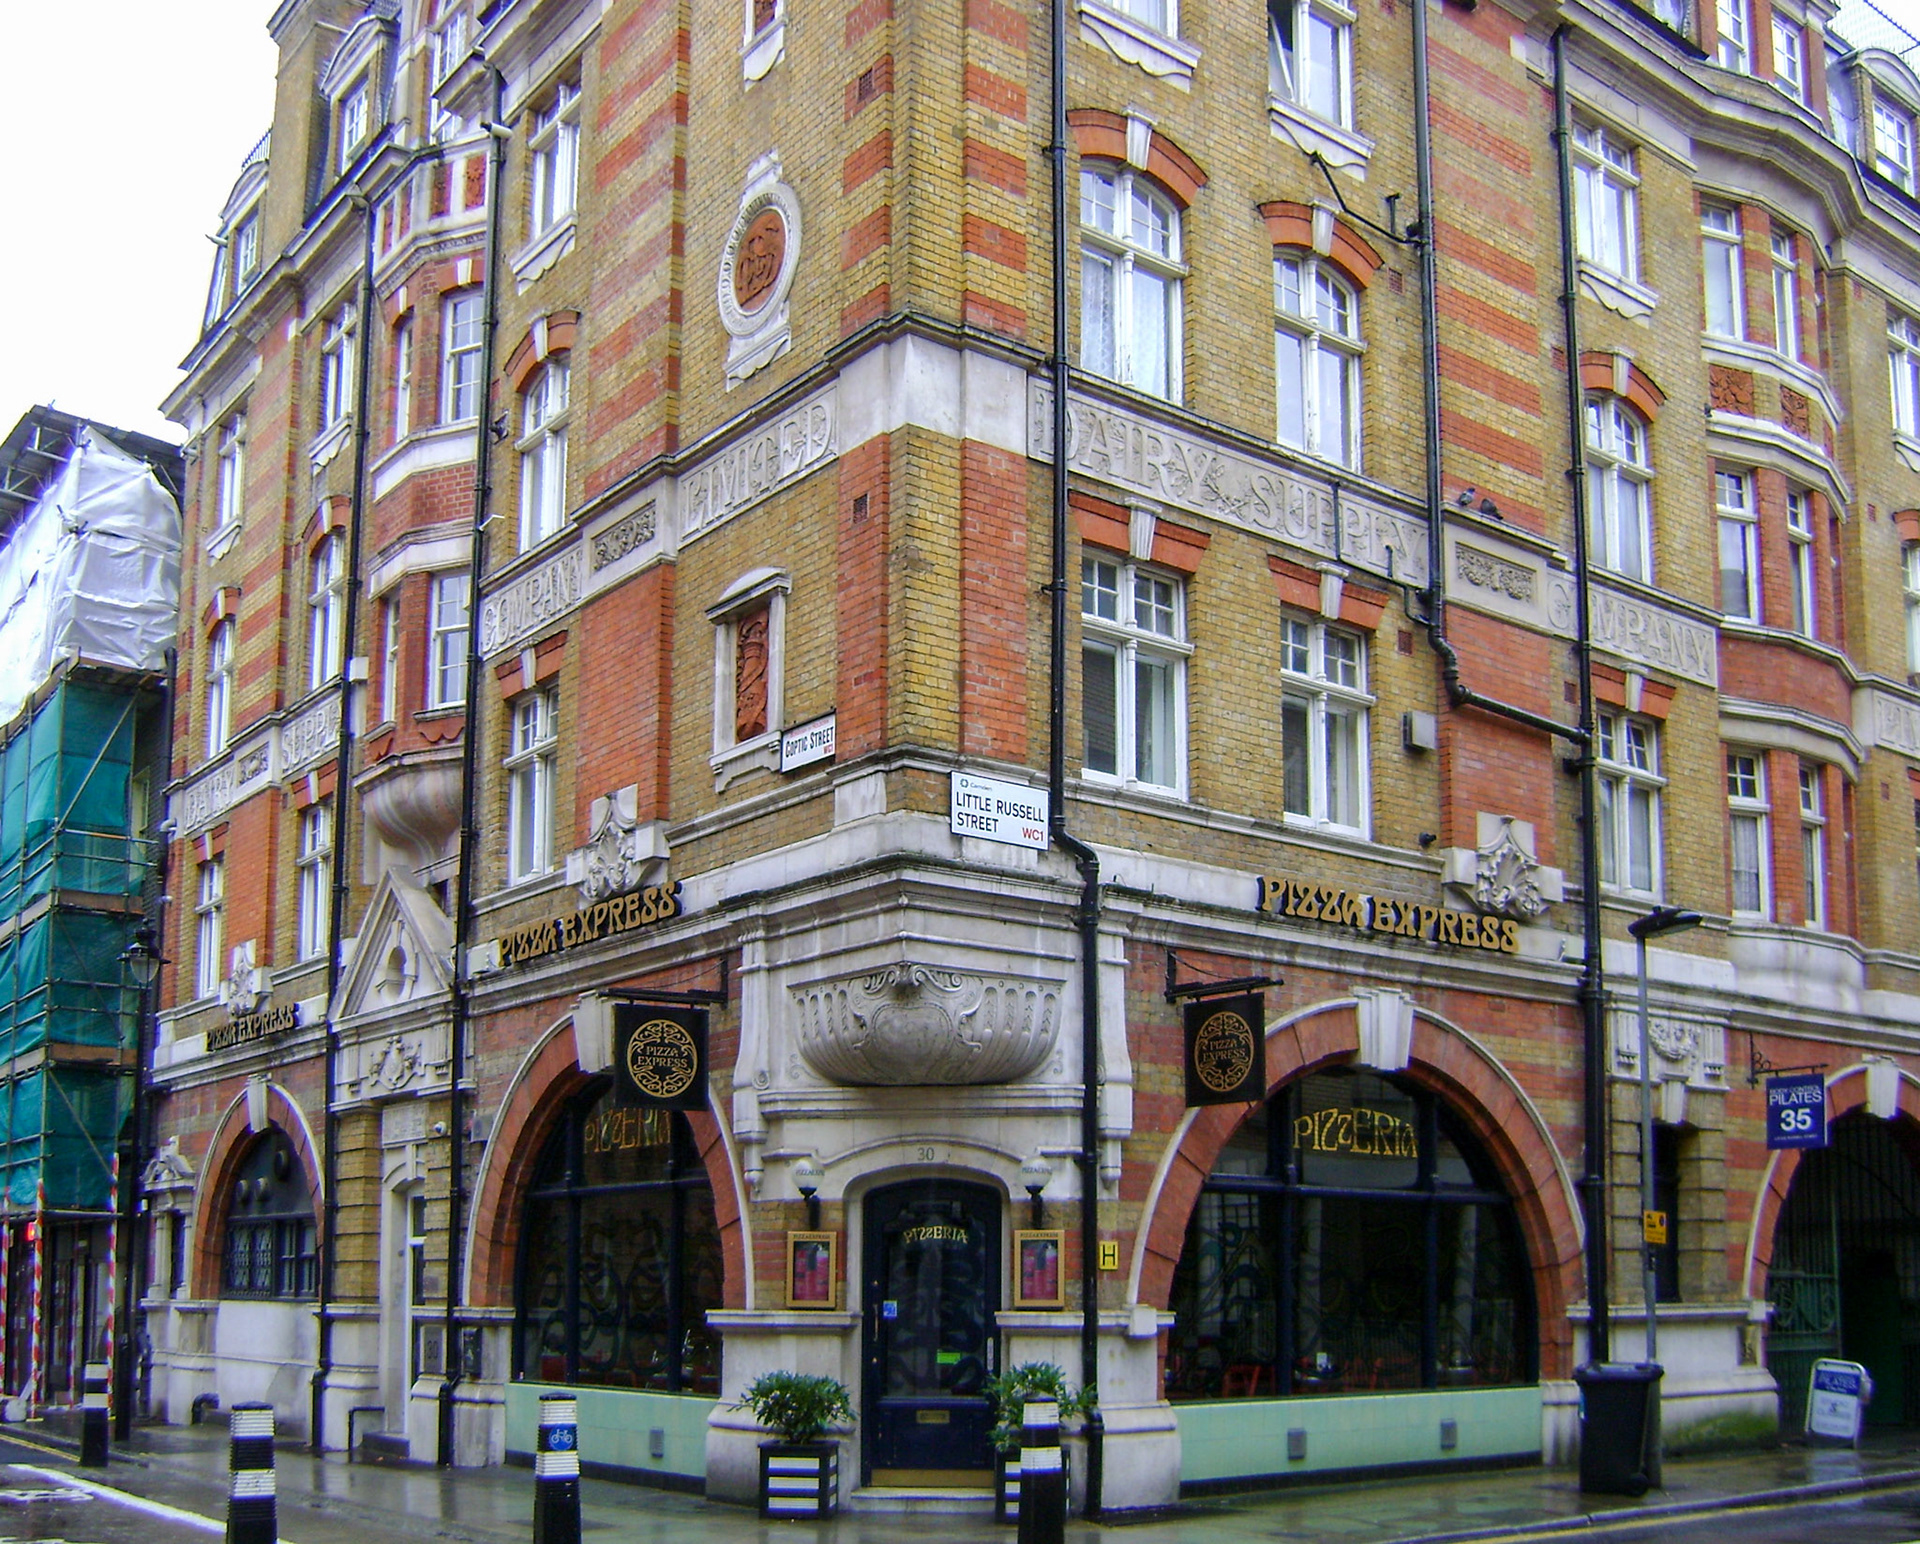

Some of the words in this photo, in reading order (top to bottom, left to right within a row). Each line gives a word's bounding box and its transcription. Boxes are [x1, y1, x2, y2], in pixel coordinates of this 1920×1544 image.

[1038, 394, 1216, 508] DAIRY
[1547, 583, 1709, 678] CMPANY
[785, 735, 808, 758] COPTIC
[810, 726, 834, 749] STREET
[956, 791, 991, 812] LITTLE
[996, 799, 1045, 823] RUSSELL
[957, 811, 999, 833] STREET
[1022, 827, 1044, 842] WC1
[498, 921, 558, 968] PIZZA
[562, 880, 678, 948] EXPRESS
[1261, 875, 1367, 928] PIZZA
[1370, 895, 1521, 955] EXPRESS
[238, 1002, 295, 1042] EXPRESS
[646, 1046, 679, 1057] PIZZA
[1202, 1047, 1246, 1062] EXPRESS
[1209, 1039, 1238, 1051] PIZZA
[637, 1055, 688, 1068] EXPRESS
[1769, 1090, 1823, 1107] PILATES
[1780, 1107, 1812, 1131] 35
[1292, 1107, 1418, 1158] PIZZERIA
[917, 1147, 935, 1161] 30
[903, 1225, 968, 1244] PIZZERIA
[1102, 1244, 1116, 1267] H
